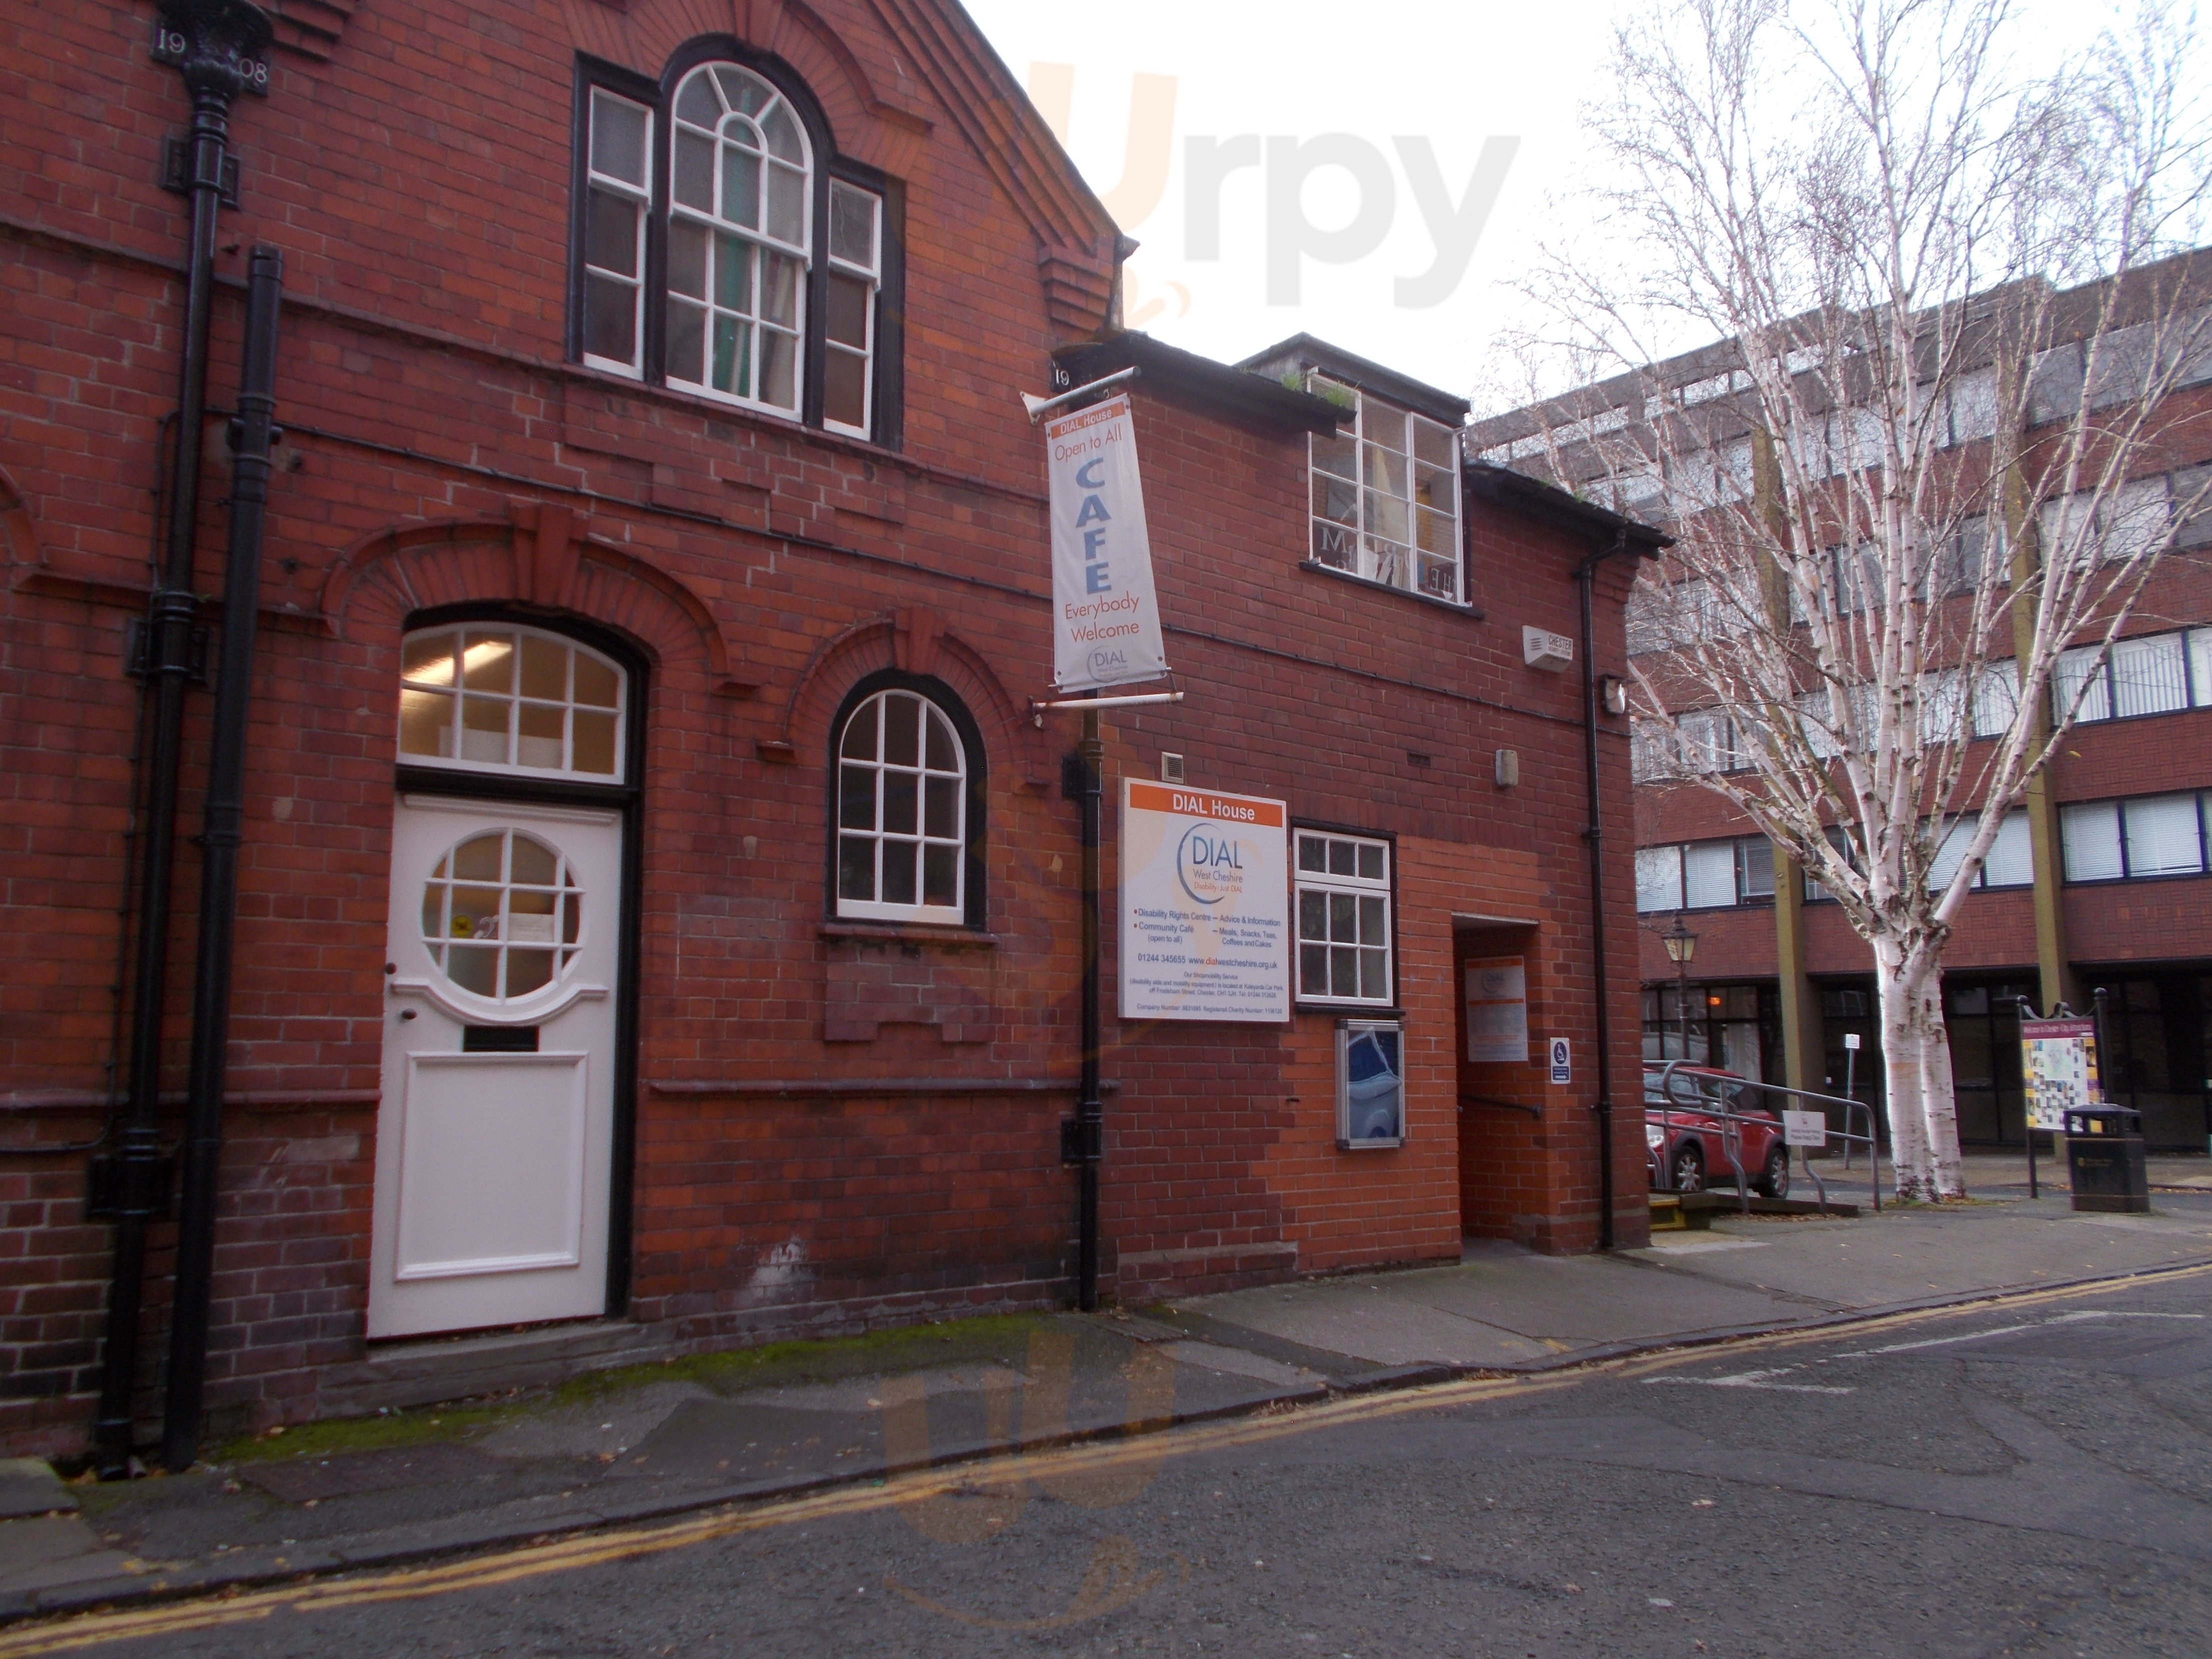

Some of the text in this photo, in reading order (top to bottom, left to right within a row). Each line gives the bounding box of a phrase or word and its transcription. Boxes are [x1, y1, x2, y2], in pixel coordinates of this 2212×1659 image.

[158, 28, 186, 54] 19
[240, 58, 267, 83] 08
[1056, 369, 1070, 386] 19
[1060, 409, 1112, 435] DIAL House
[1055, 423, 1122, 463] Open to All
[1075, 457, 1112, 594] CAFE
[1066, 590, 1140, 620] Everybody
[1071, 622, 1140, 642] Welcome
[1548, 634, 1572, 650] CHESTER
[1094, 650, 1128, 666] DIAL
[1173, 794, 1255, 820] DIAL House
[1192, 835, 1243, 869] DIAL
[1193, 868, 1243, 882] West Cheshire
[1194, 882, 1217, 892] Disability
[1138, 908, 1168, 920] Disability
[1169, 910, 1190, 921] Rights
[1191, 912, 1212, 921] Centre
[1220, 914, 1240, 923] Advice
[1248, 916, 1280, 926] Information
[1139, 922, 1178, 934] Community
[1180, 924, 1194, 933] Café
[1219, 927, 1238, 938] Meals,
[1240, 929, 1262, 938] Snacks,
[1263, 930, 1277, 940] Teas,
[1148, 934, 1164, 944] (open
[1174, 936, 1182, 944] all)
[1222, 938, 1243, 946] Coffees
[1138, 953, 1278, 970] 01244 345655 www.dialwestcheshire.org.uk
[1193, 972, 1222, 980] Shopmobility
[1137, 1003, 1160, 1011] Company
